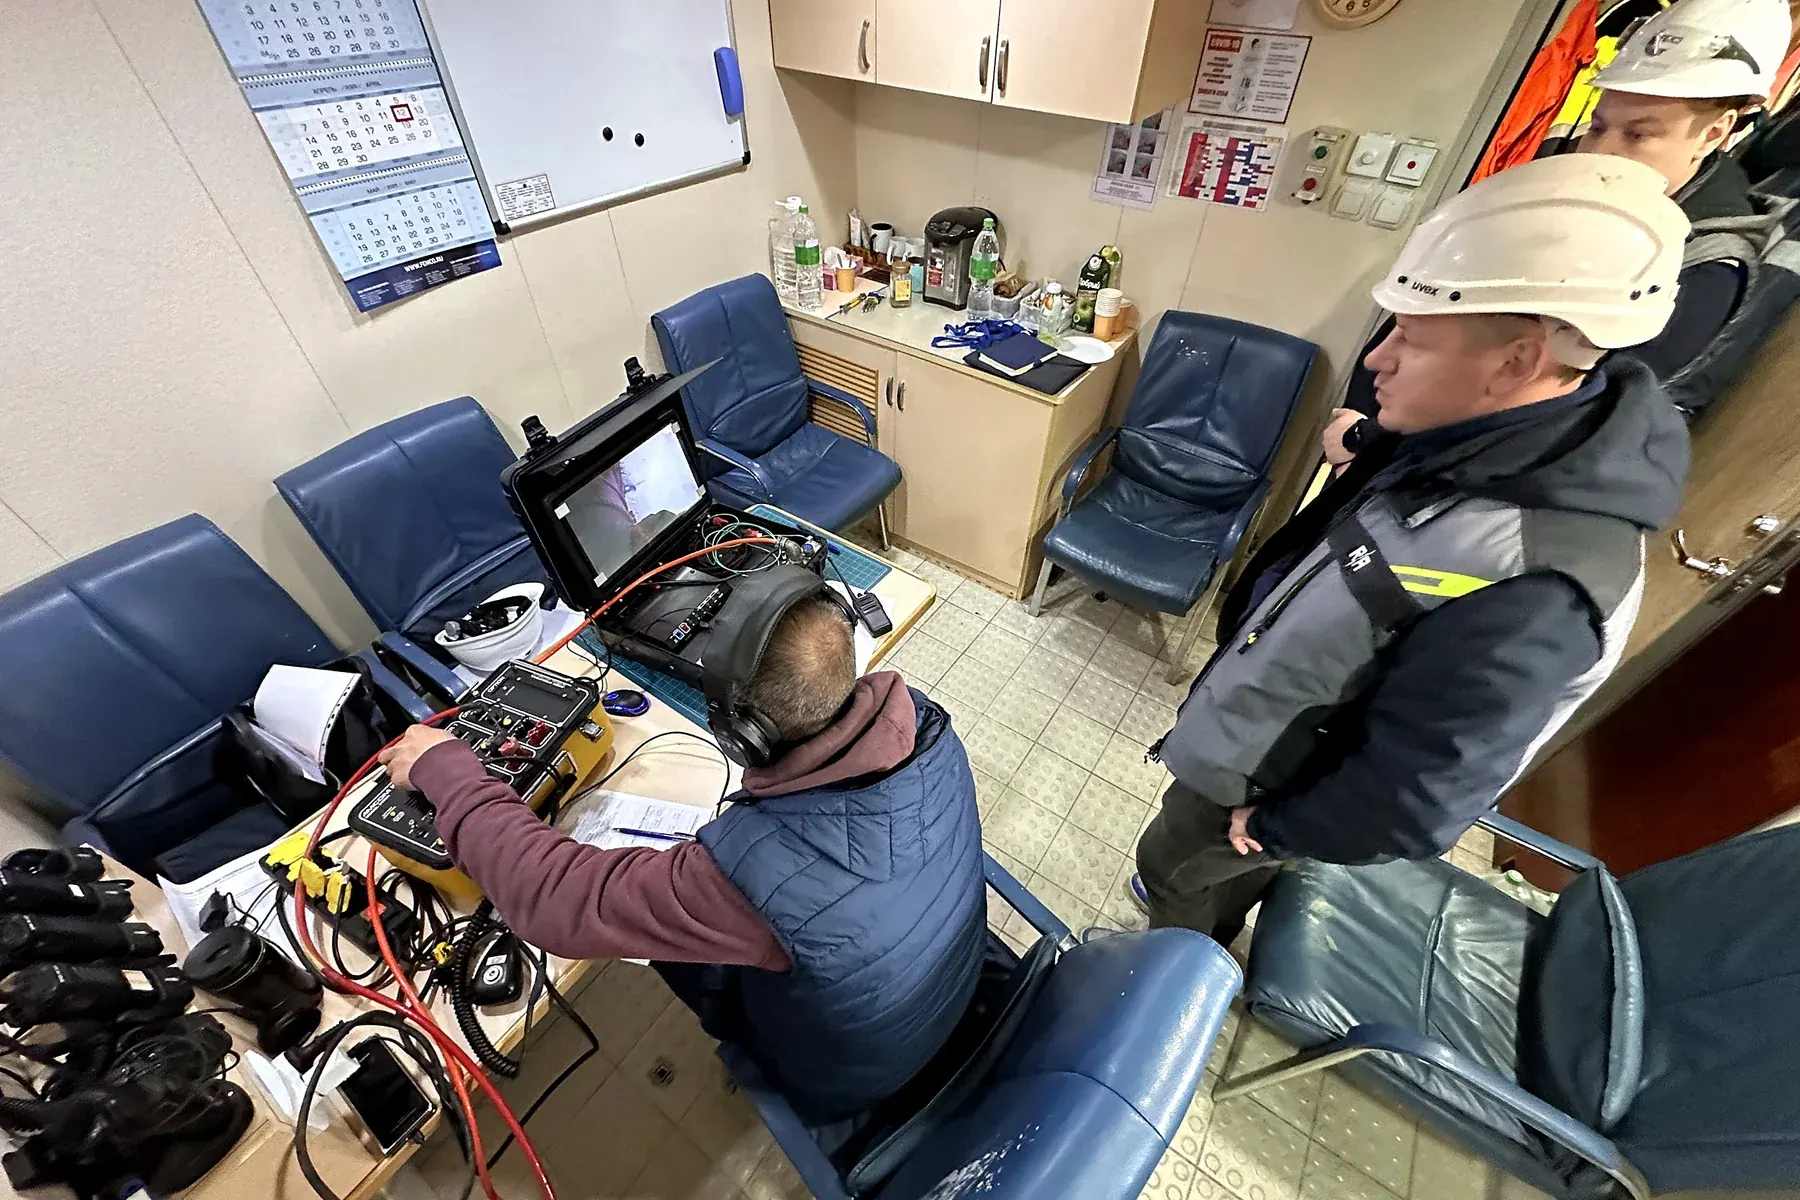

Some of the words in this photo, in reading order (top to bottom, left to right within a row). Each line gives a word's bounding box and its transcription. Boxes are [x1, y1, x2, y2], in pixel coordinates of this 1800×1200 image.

[246, 6, 254, 15] 3
[269, 4, 277, 13] 4
[291, 3, 299, 12] 5
[314, 1, 320, 10] 6
[336, 0, 341, 9] 7
[251, 20, 264, 30] 10
[274, 19, 286, 29] 11
[296, 18, 308, 27] 12
[318, 16, 330, 26] 13
[339, 15, 350, 24] 14
[360, 14, 370, 23] 15
[379, 13, 389, 21] 16
[258, 36, 269, 45] 17
[281, 34, 293, 44] 18
[303, 32, 315, 42] 19
[323, 31, 336, 40] 20
[344, 30, 356, 38] 21
[364, 28, 375, 37] 22
[383, 26, 394, 35] 23
[287, 49, 300, 58] 25
[308, 47, 321, 56] 26
[329, 45, 340, 54] 27
[350, 44, 362, 52] 28
[370, 41, 380, 50] 29
[388, 40, 399, 48] 30
[337, 105, 343, 113] 2
[356, 102, 362, 110] 3
[306, 136, 318, 145] 14
[326, 133, 338, 141] 15
[365, 127, 375, 135] 17
[311, 149, 322, 158] 21
[317, 162, 329, 170] 28
[1411, 281, 1440, 297] uvex
